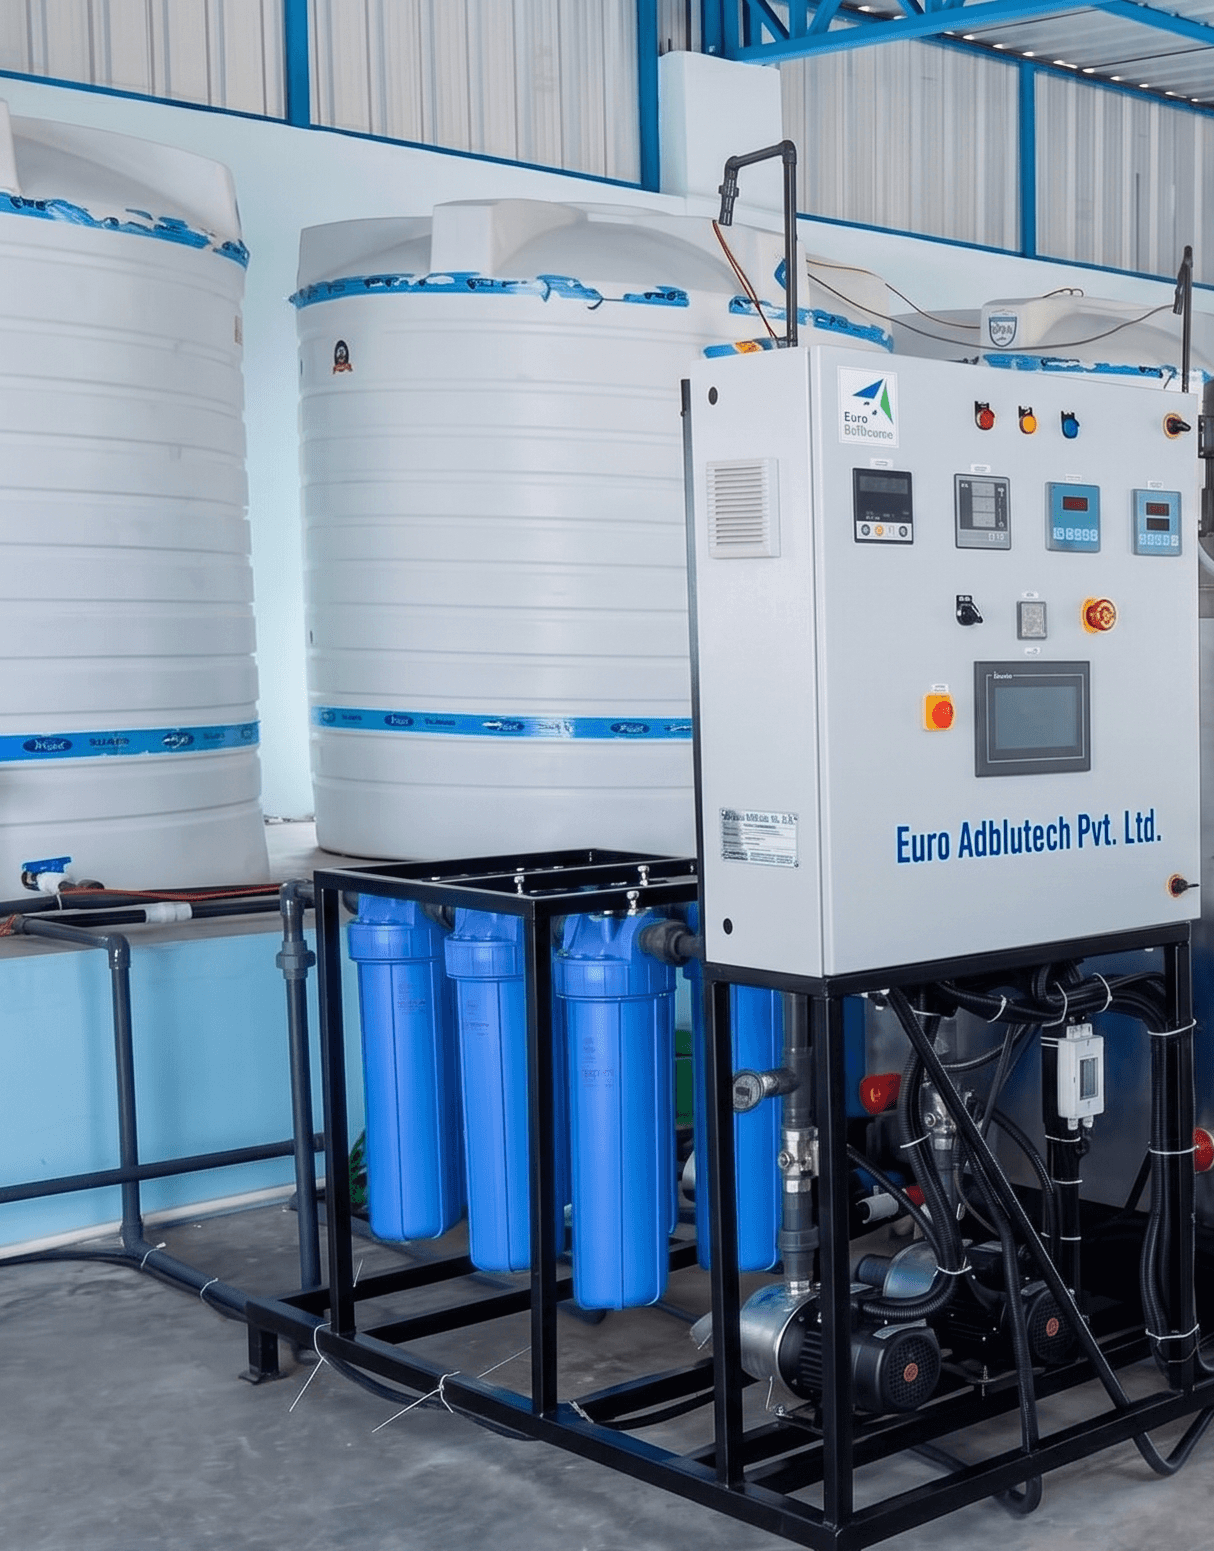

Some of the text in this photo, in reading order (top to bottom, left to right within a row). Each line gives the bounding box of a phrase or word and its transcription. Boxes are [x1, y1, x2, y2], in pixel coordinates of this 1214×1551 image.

[844, 411, 868, 424] Euro
[896, 808, 1162, 863] Euro Adblutech Pvt. Ltd.
